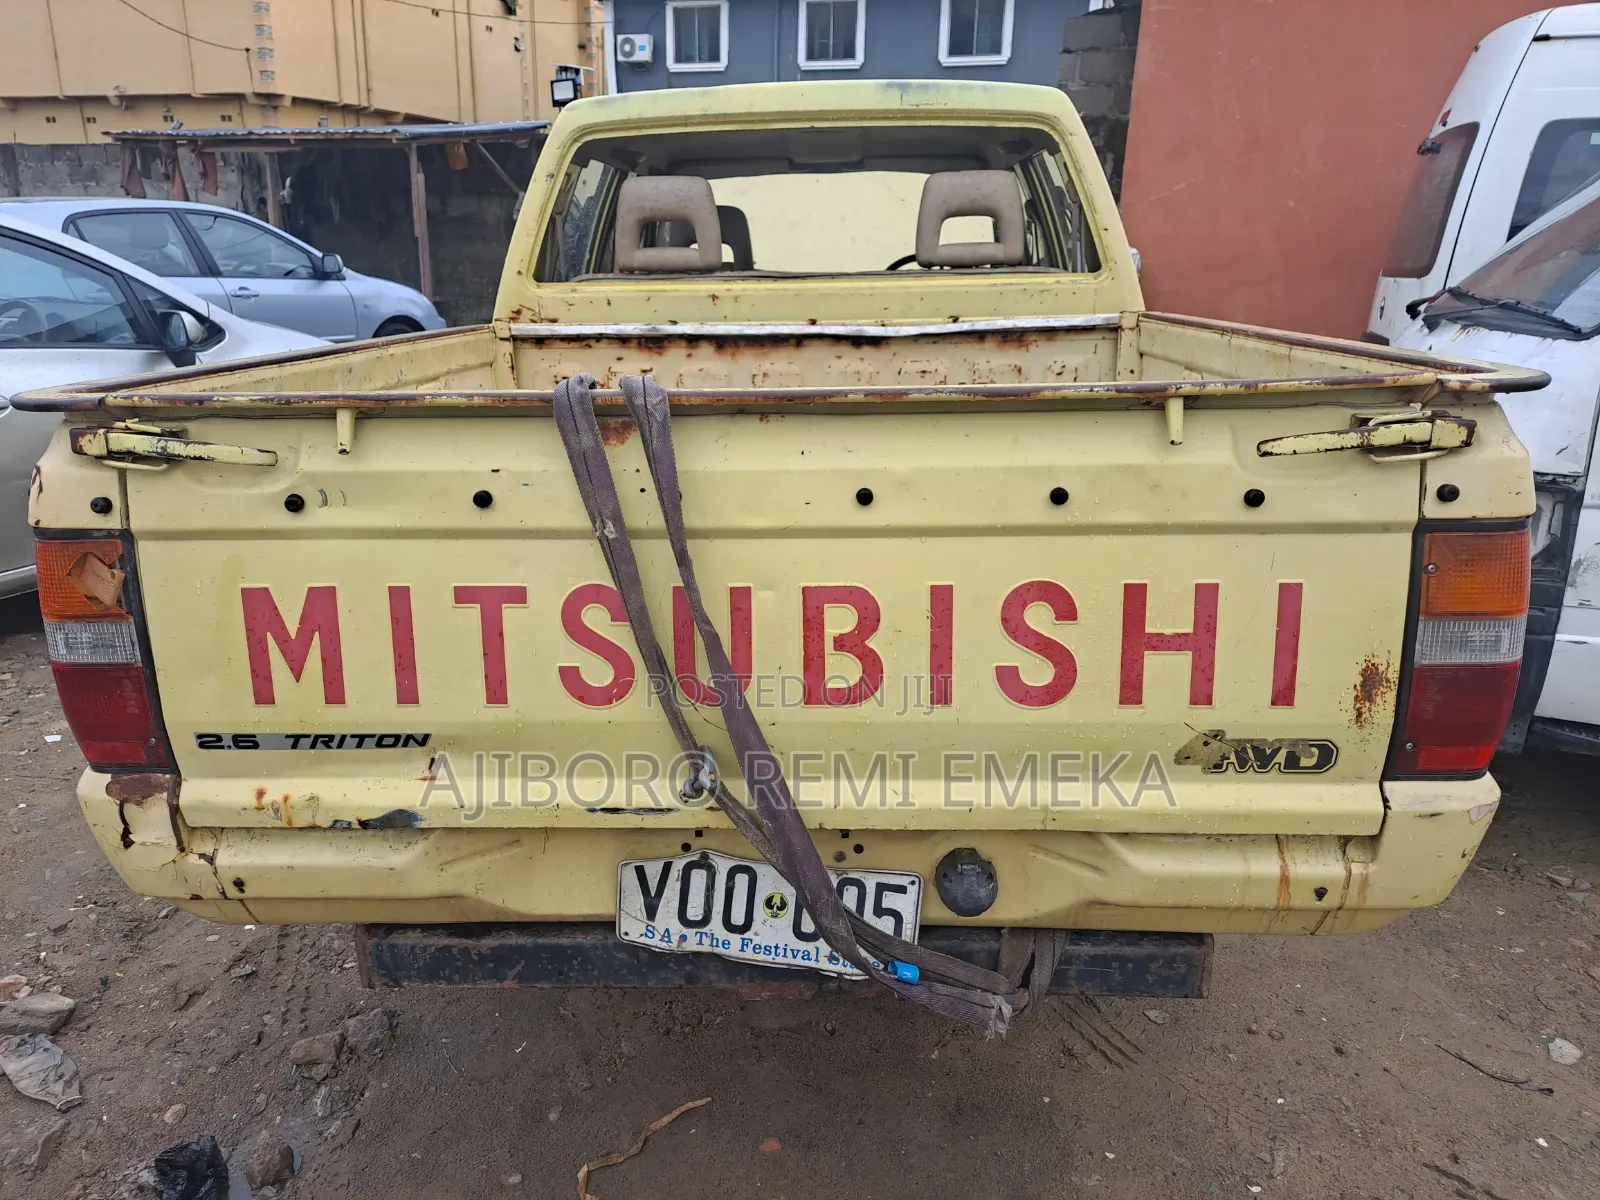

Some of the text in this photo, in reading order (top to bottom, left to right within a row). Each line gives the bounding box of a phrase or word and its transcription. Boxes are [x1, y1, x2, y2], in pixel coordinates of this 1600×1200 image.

[240, 580, 1304, 707] MITSUBISHI
[196, 733, 431, 750] 2.6 TRITON
[695, 931, 731, 950] The
[738, 937, 820, 963] Festival
